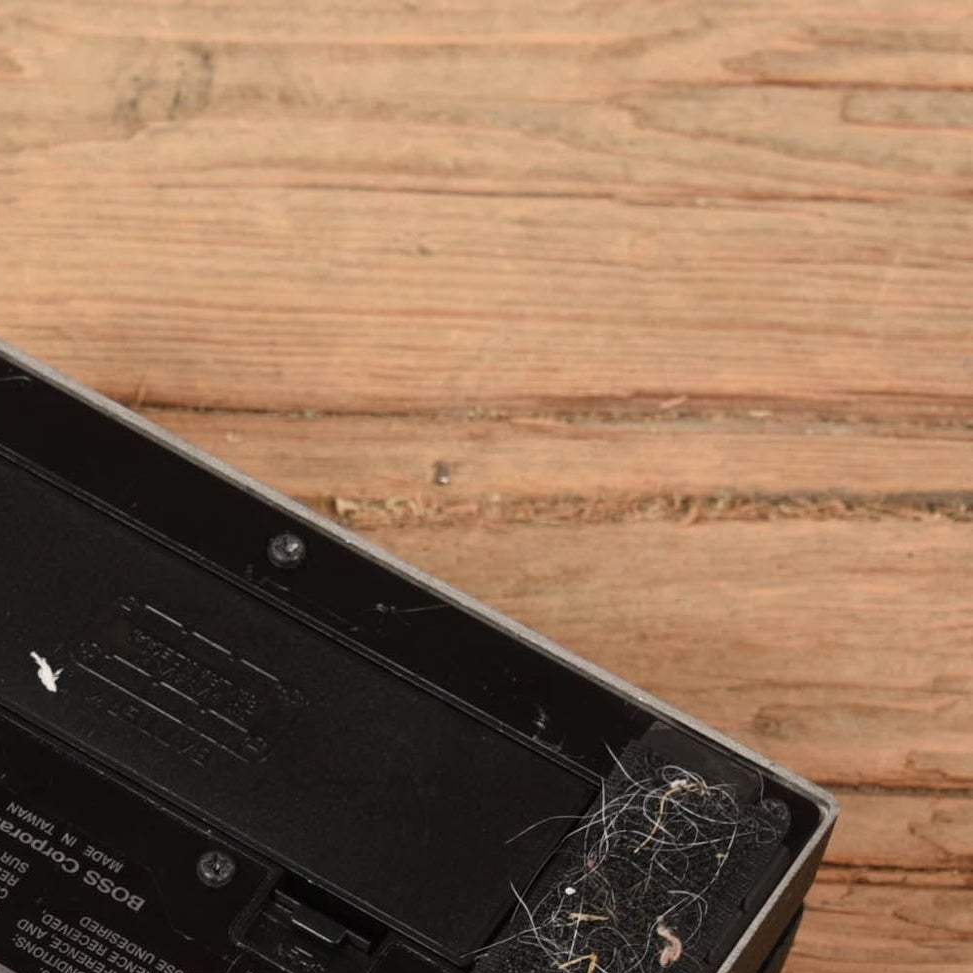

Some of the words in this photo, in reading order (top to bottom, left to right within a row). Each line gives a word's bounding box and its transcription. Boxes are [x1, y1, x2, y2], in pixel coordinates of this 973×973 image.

[4, 800, 56, 836] TAIWAN
[59, 831, 78, 848] IN
[82, 843, 124, 874] MADE
[81, 868, 146, 912] BOSS
[15, 917, 49, 940] AND
[40, 908, 109, 957] RECEIVED,
[77, 914, 156, 965] UNDESIRED
